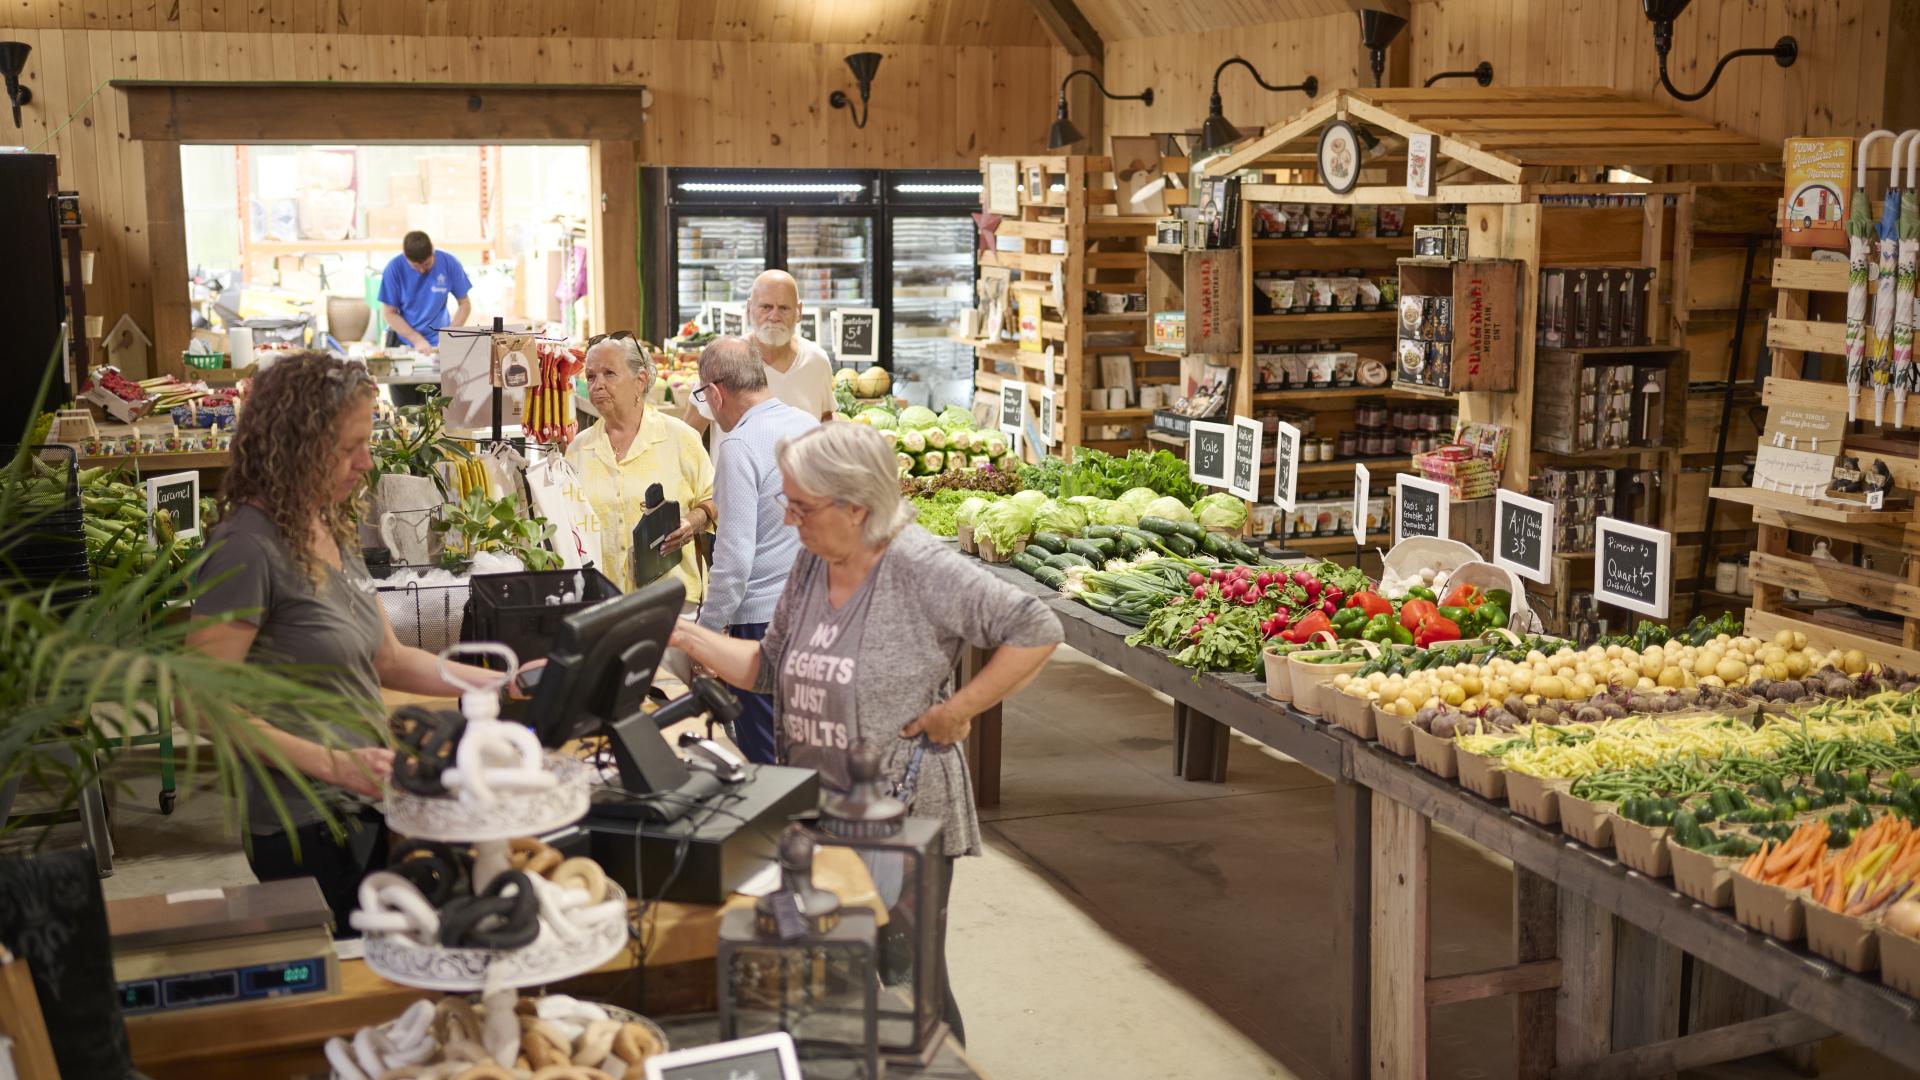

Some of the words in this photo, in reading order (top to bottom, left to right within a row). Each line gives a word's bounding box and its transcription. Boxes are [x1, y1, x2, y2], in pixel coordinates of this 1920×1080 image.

[1793, 142, 1825, 152] TODAY'S
[1201, 437, 1219, 454] Kale
[157, 484, 190, 504] Caramel
[1511, 537, 1527, 560] 3$
[1608, 536, 1636, 553] Piment
[1607, 558, 1638, 584] Quart
[810, 622, 839, 649] NO
[784, 650, 855, 684] EGRETS
[790, 683, 826, 714] JUST
